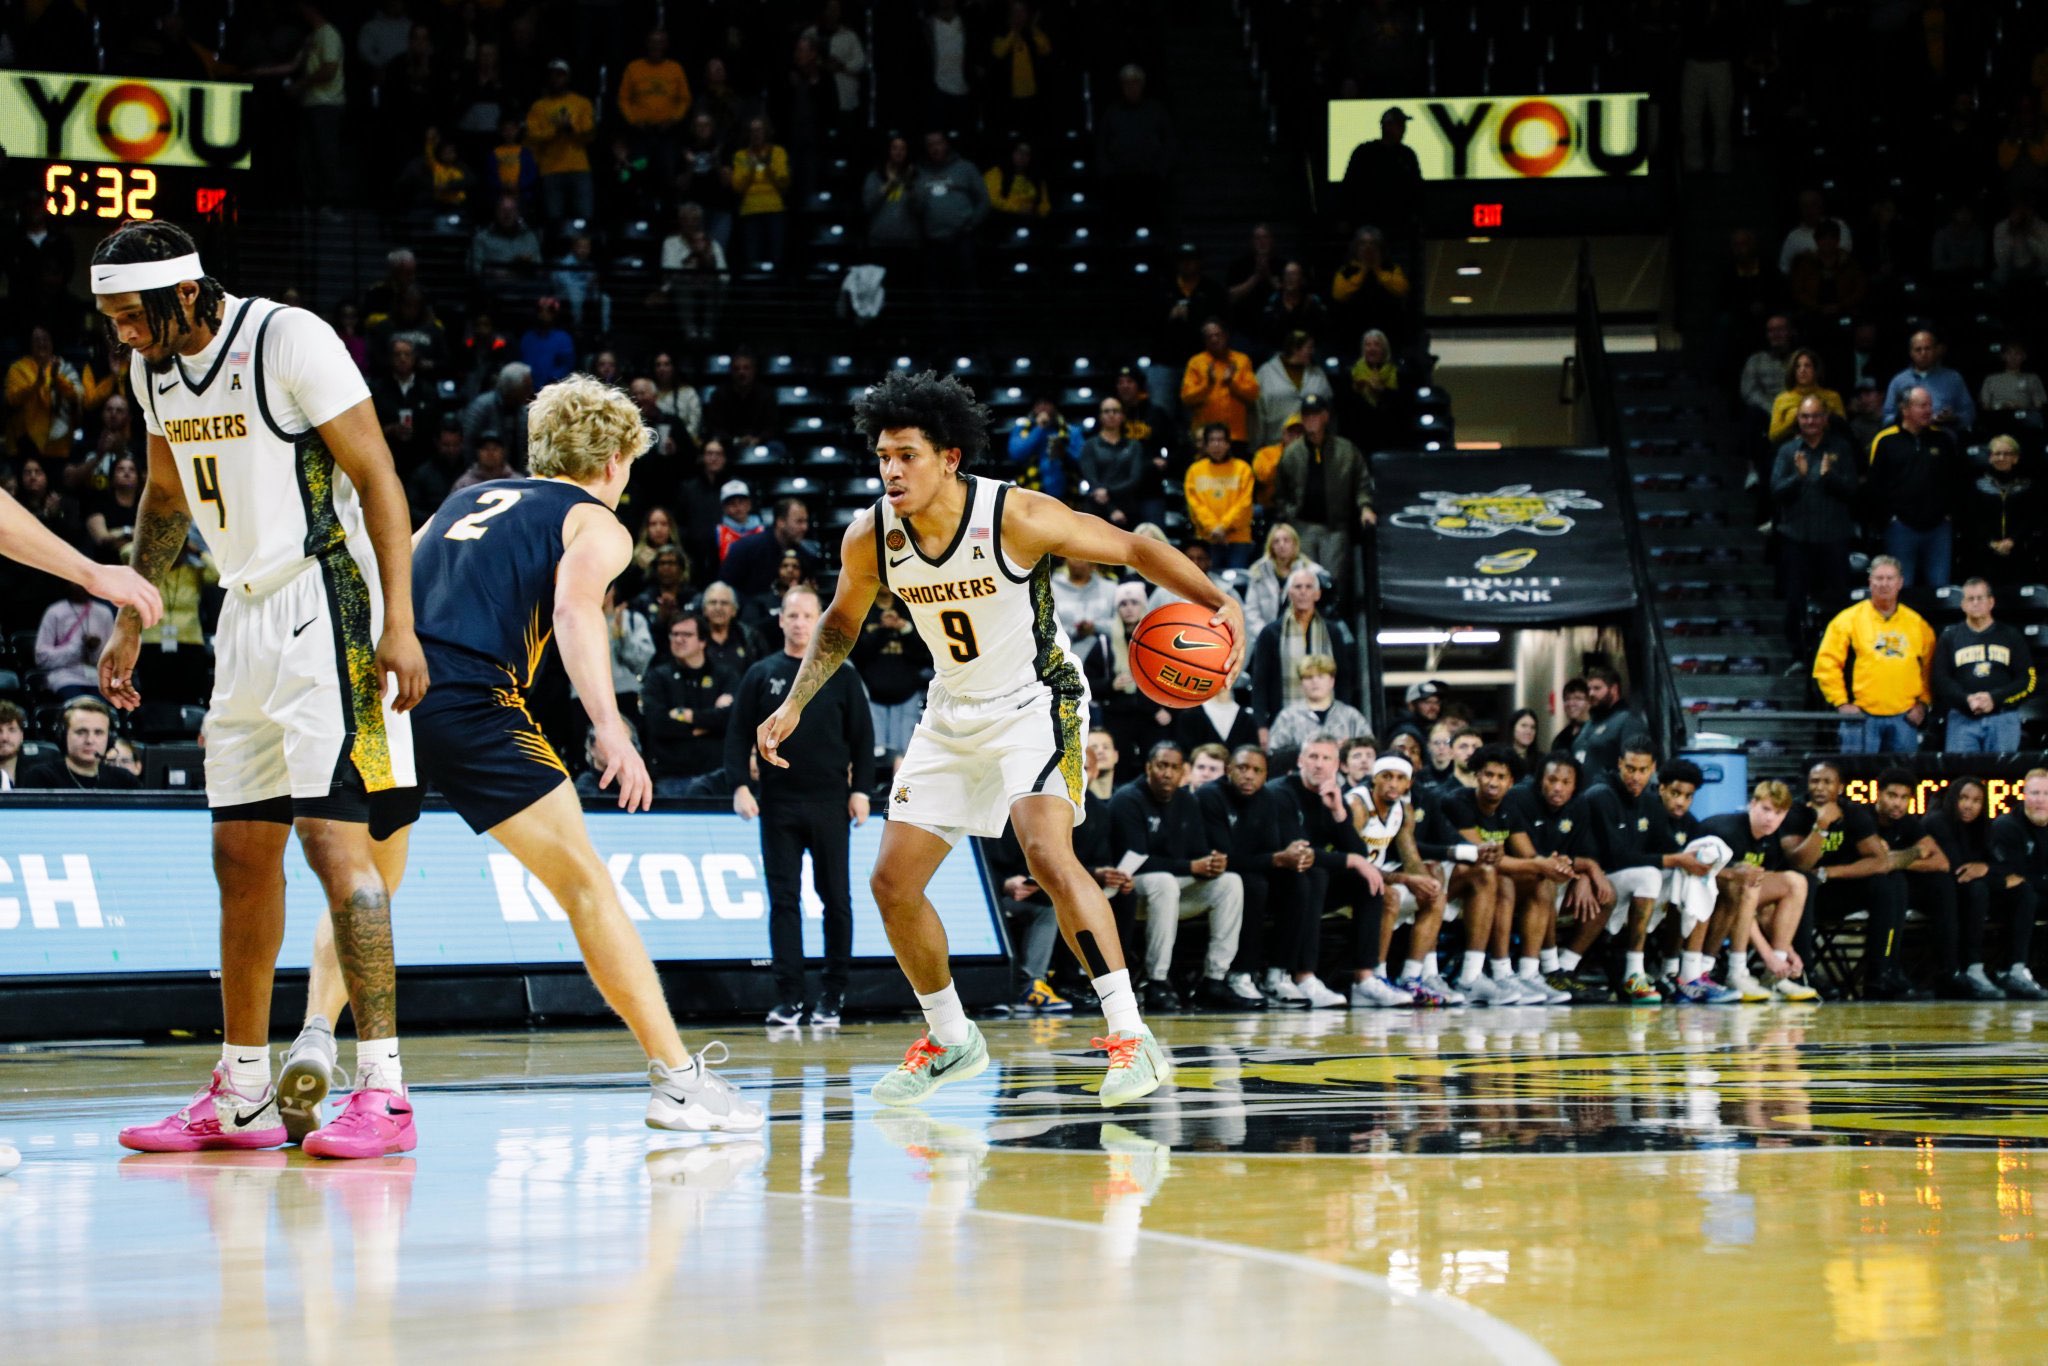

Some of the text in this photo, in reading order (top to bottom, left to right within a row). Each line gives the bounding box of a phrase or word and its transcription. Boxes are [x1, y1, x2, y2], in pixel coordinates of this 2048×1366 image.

[20, 77, 251, 164] YOU
[1426, 97, 1648, 177] YOU
[1473, 204, 1503, 227] EXIT
[164, 413, 248, 444] SHOCKERS
[192, 455, 227, 532] 4
[443, 489, 522, 541] 2
[897, 576, 997, 604] SHOCKERS
[939, 608, 980, 664] 9
[1159, 664, 1213, 692] ELITE
[602, 853, 826, 921] KOC
